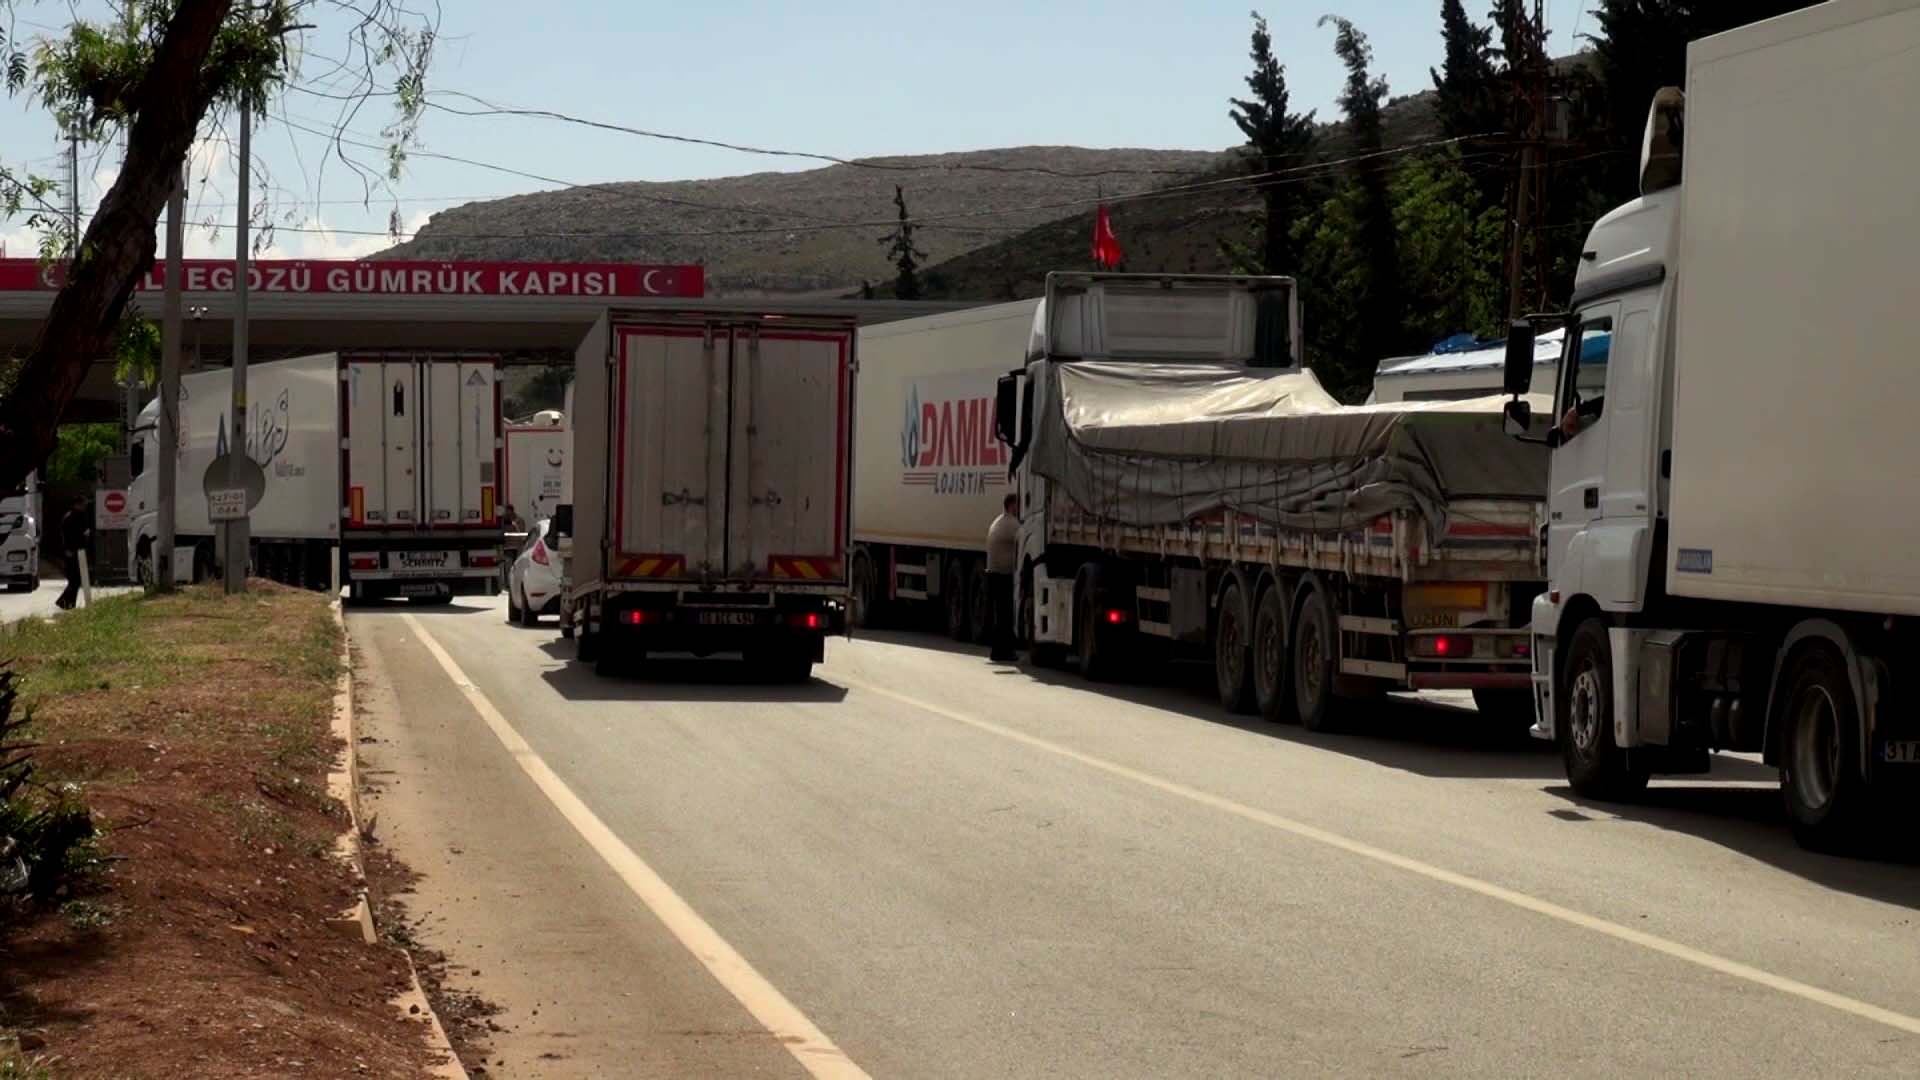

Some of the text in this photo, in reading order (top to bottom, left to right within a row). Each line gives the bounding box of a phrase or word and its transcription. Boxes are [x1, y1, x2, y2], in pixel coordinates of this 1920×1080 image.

[328, 262, 484, 293] GÜMRÜK
[499, 270, 616, 295] KAPISI
[402, 559, 446, 568] SCHMITZ
